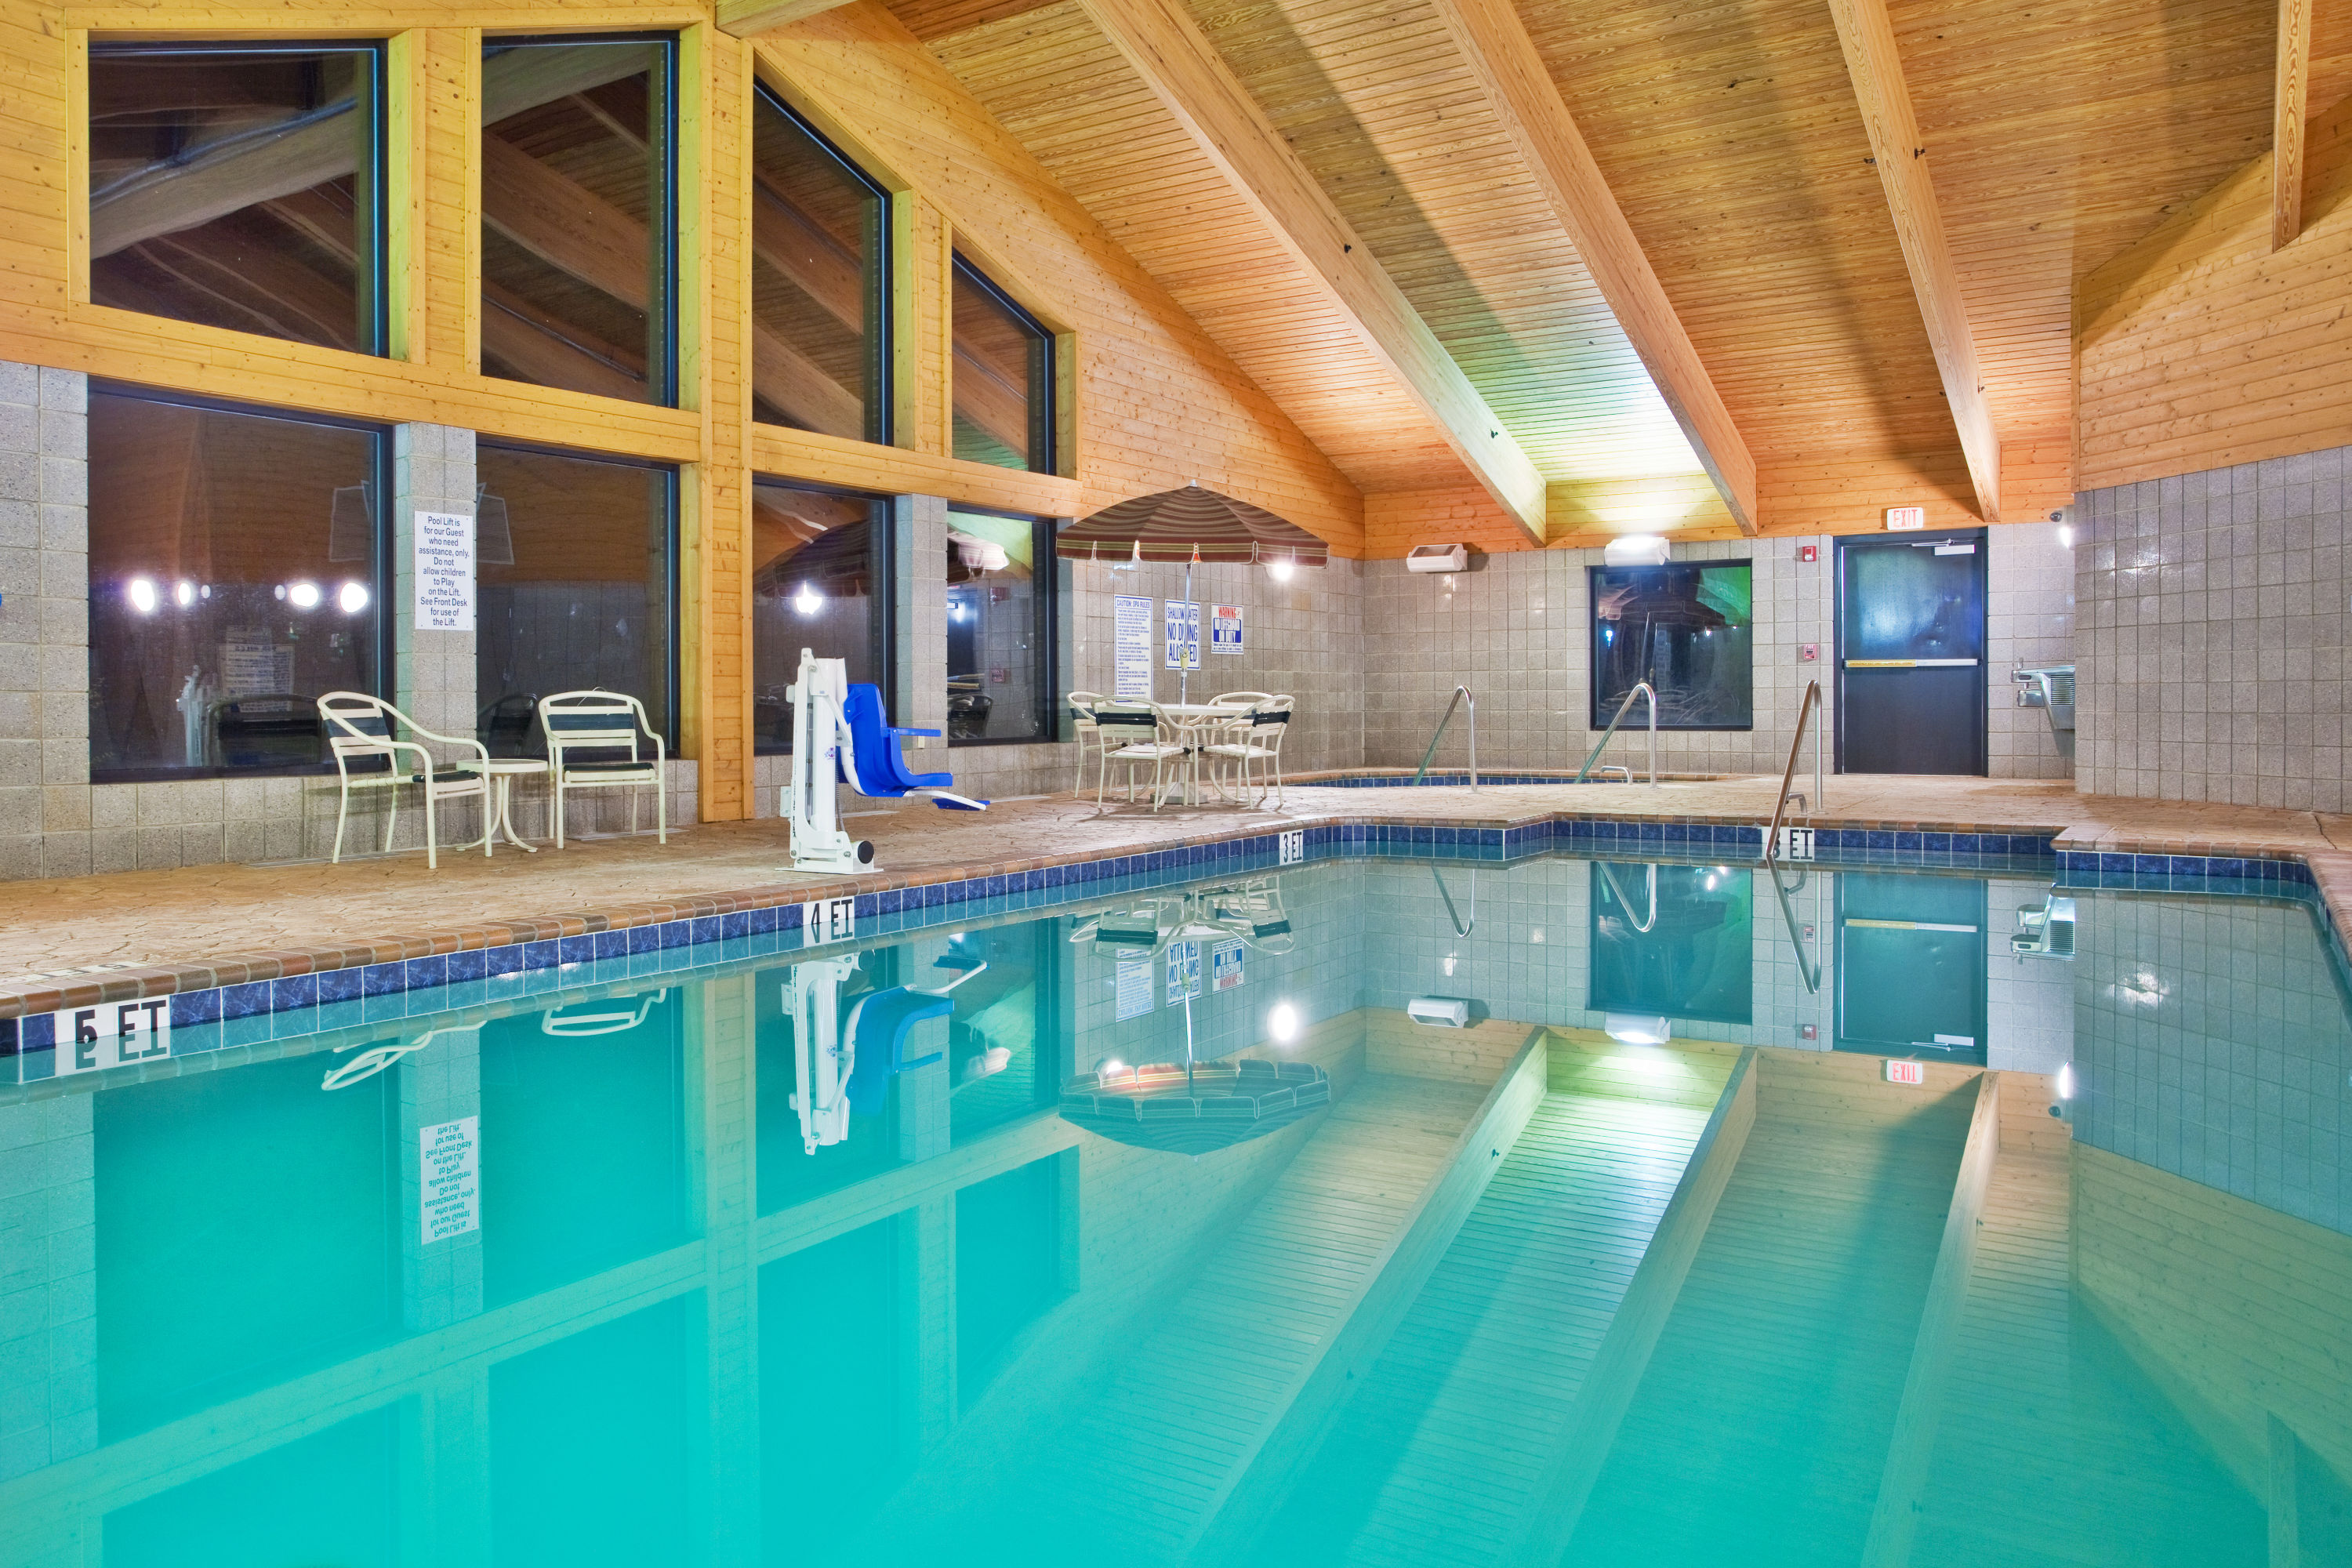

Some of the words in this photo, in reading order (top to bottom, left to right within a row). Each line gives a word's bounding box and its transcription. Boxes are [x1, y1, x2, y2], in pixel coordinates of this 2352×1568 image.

[444, 517, 453, 526] Lift
[1894, 510, 1917, 527] EXIT
[441, 578, 455, 587] Play
[452, 598, 467, 607] Desk
[1188, 609, 1197, 621] ATER
[1168, 622, 1176, 640] NO
[1179, 623, 1197, 641] DIING
[1169, 643, 1197, 662] ALLED
[811, 903, 822, 924] 4
[75, 1009, 97, 1044] 5
